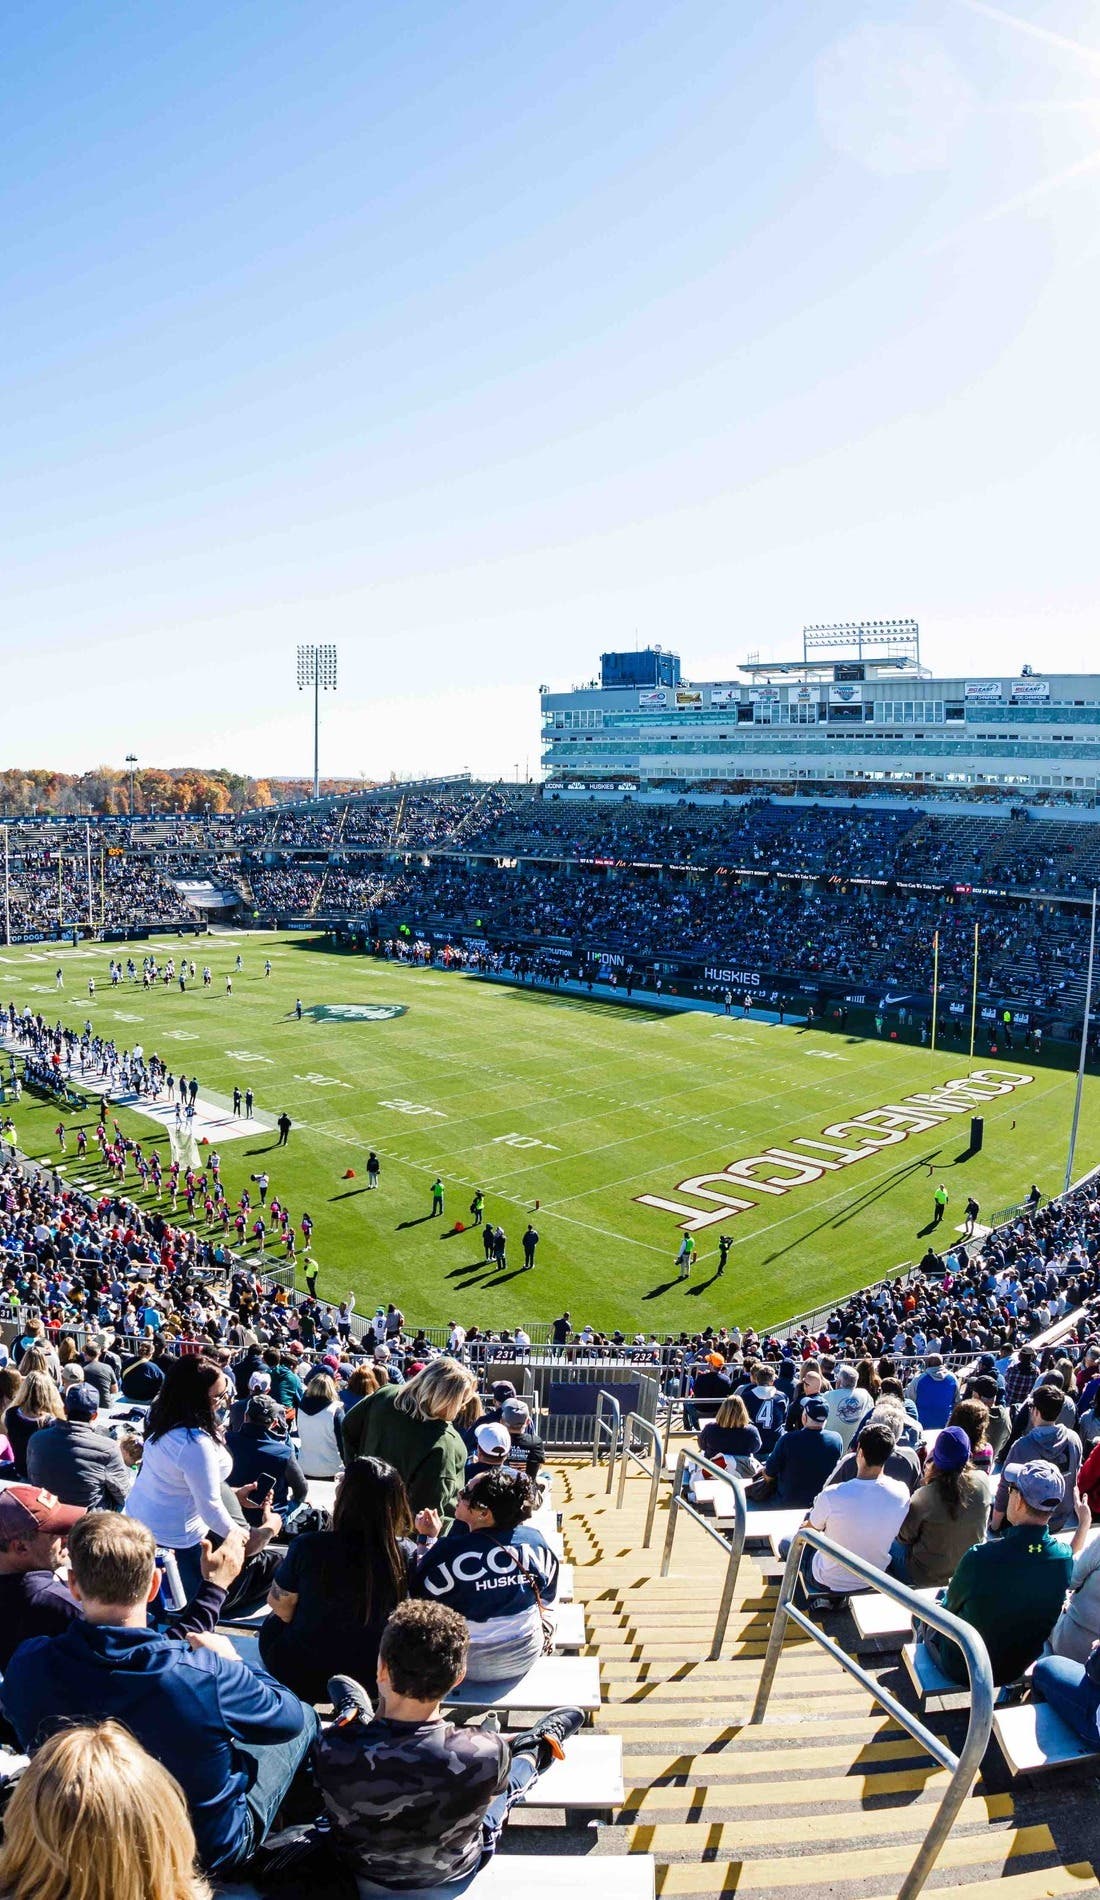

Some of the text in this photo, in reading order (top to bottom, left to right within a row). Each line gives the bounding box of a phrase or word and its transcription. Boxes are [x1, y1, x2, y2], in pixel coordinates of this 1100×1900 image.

[705, 967, 760, 986] HUSKIES
[293, 1072, 339, 1087] 30
[377, 1098, 433, 1115] 20
[492, 1132, 543, 1149] 10
[630, 1069, 1036, 1232] CONNECTICUT
[377, 1320, 383, 1329] 6
[496, 1351, 515, 1360] 231
[633, 1353, 652, 1361] 232
[755, 1399, 774, 1430] 4
